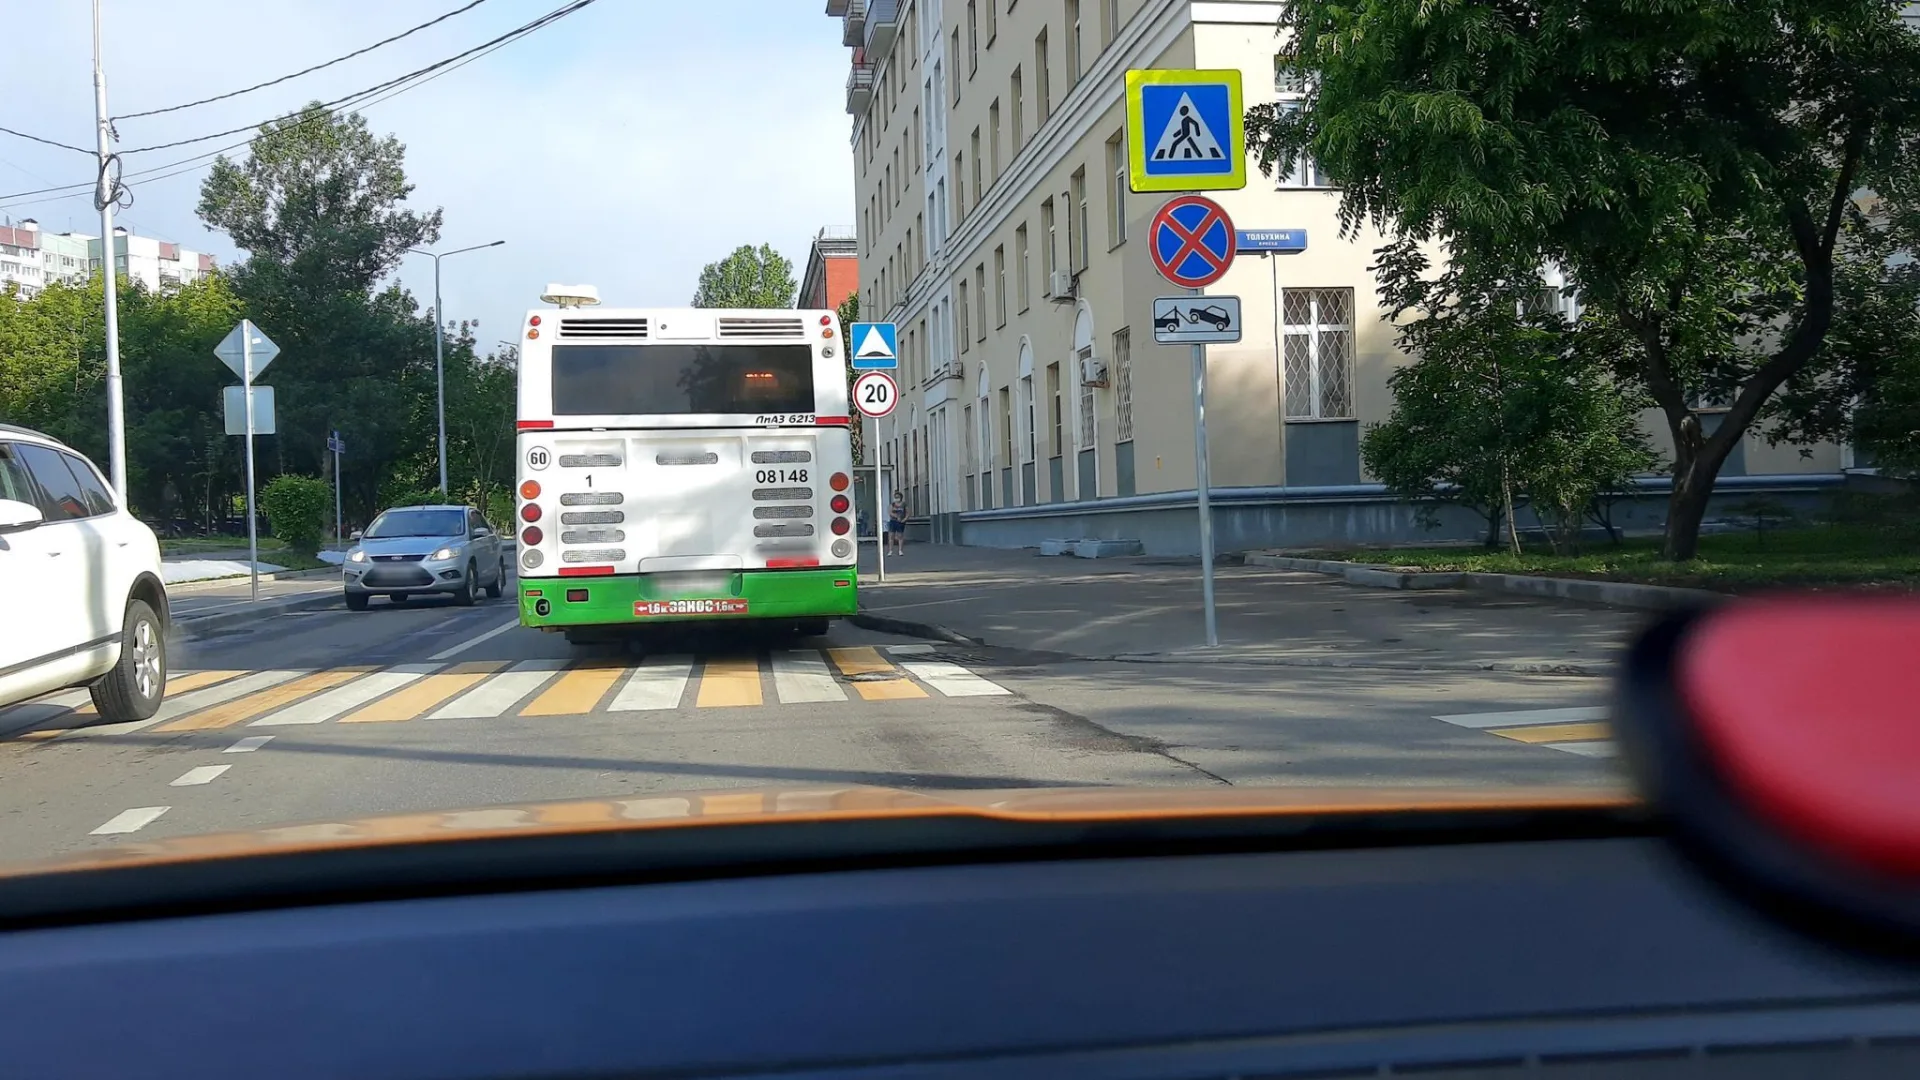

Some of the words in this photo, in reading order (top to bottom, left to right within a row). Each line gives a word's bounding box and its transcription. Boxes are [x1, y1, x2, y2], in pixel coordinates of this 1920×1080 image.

[1245, 233, 1290, 241] ТОЛБУХИНА
[865, 384, 887, 403] 20
[788, 414, 816, 423] 6213
[530, 452, 547, 465] 60
[585, 474, 592, 488] 1
[755, 469, 809, 484] 08148
